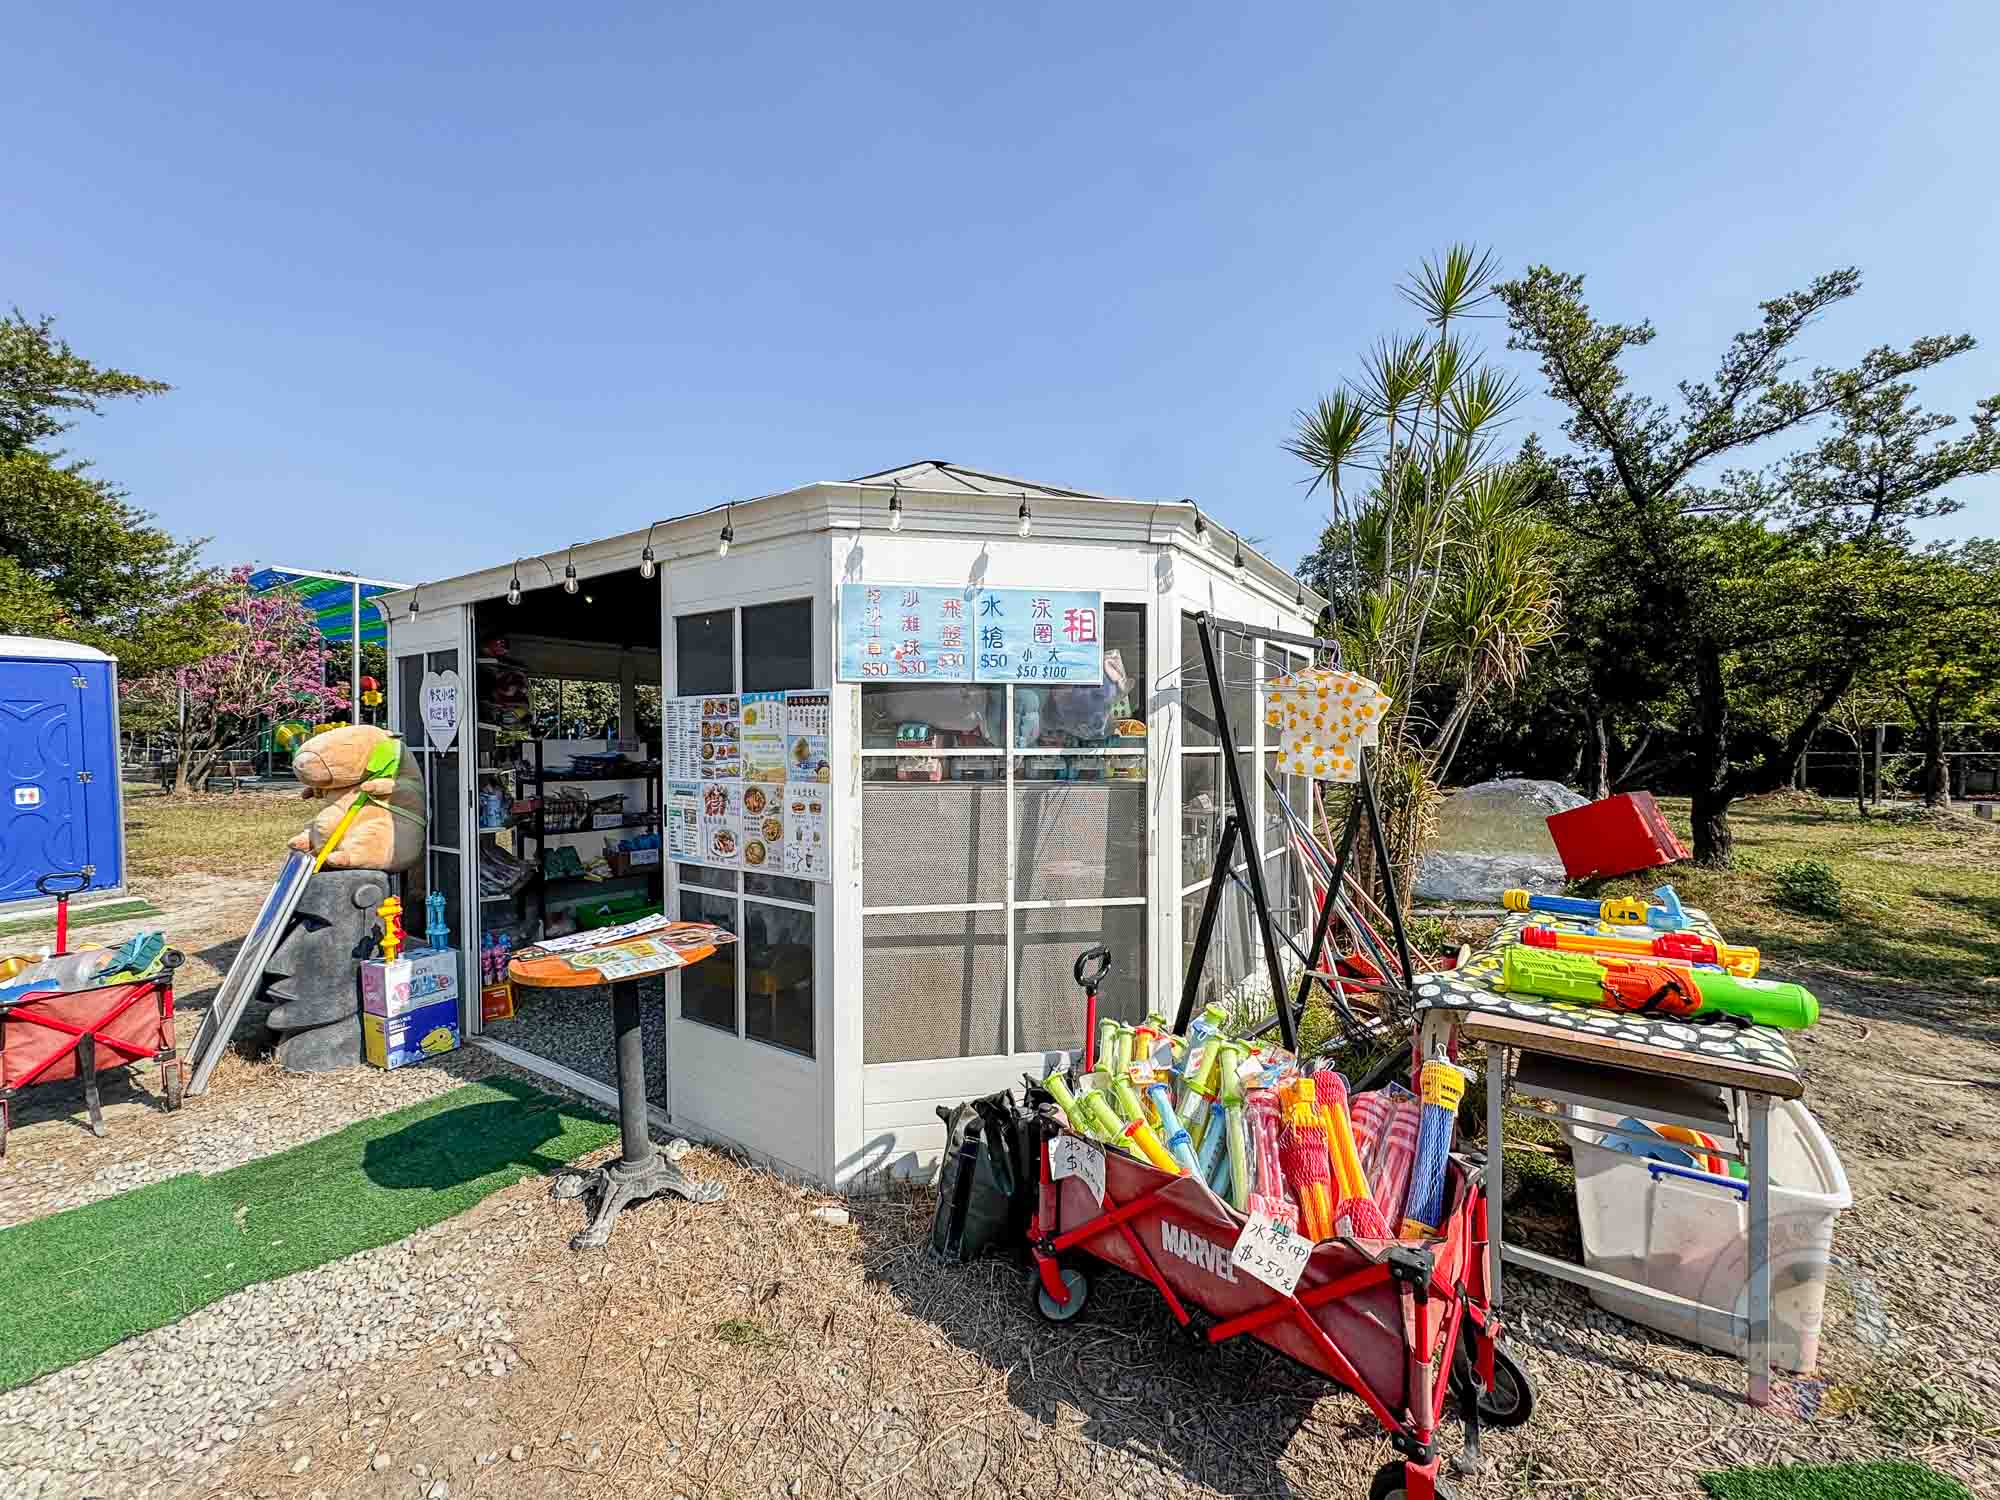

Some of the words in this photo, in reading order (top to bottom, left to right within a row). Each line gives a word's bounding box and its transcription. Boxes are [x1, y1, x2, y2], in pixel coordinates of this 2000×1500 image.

[902, 590, 920, 656] 沙灘球
[942, 598, 962, 648] 飛盤
[979, 595, 1003, 649] 水槍
[1031, 598, 1053, 643] 泳圈
[1063, 607, 1097, 642] 租
[862, 662, 889, 677] $50
[899, 659, 927, 674] $30
[981, 653, 1007, 669] $50
[1016, 664, 1038, 679] $50
[1041, 664, 1067, 679] $100
[1022, 648, 1032, 662] 小
[1048, 647, 1060, 662] 大
[1161, 1219, 1239, 1284] MARVEL
